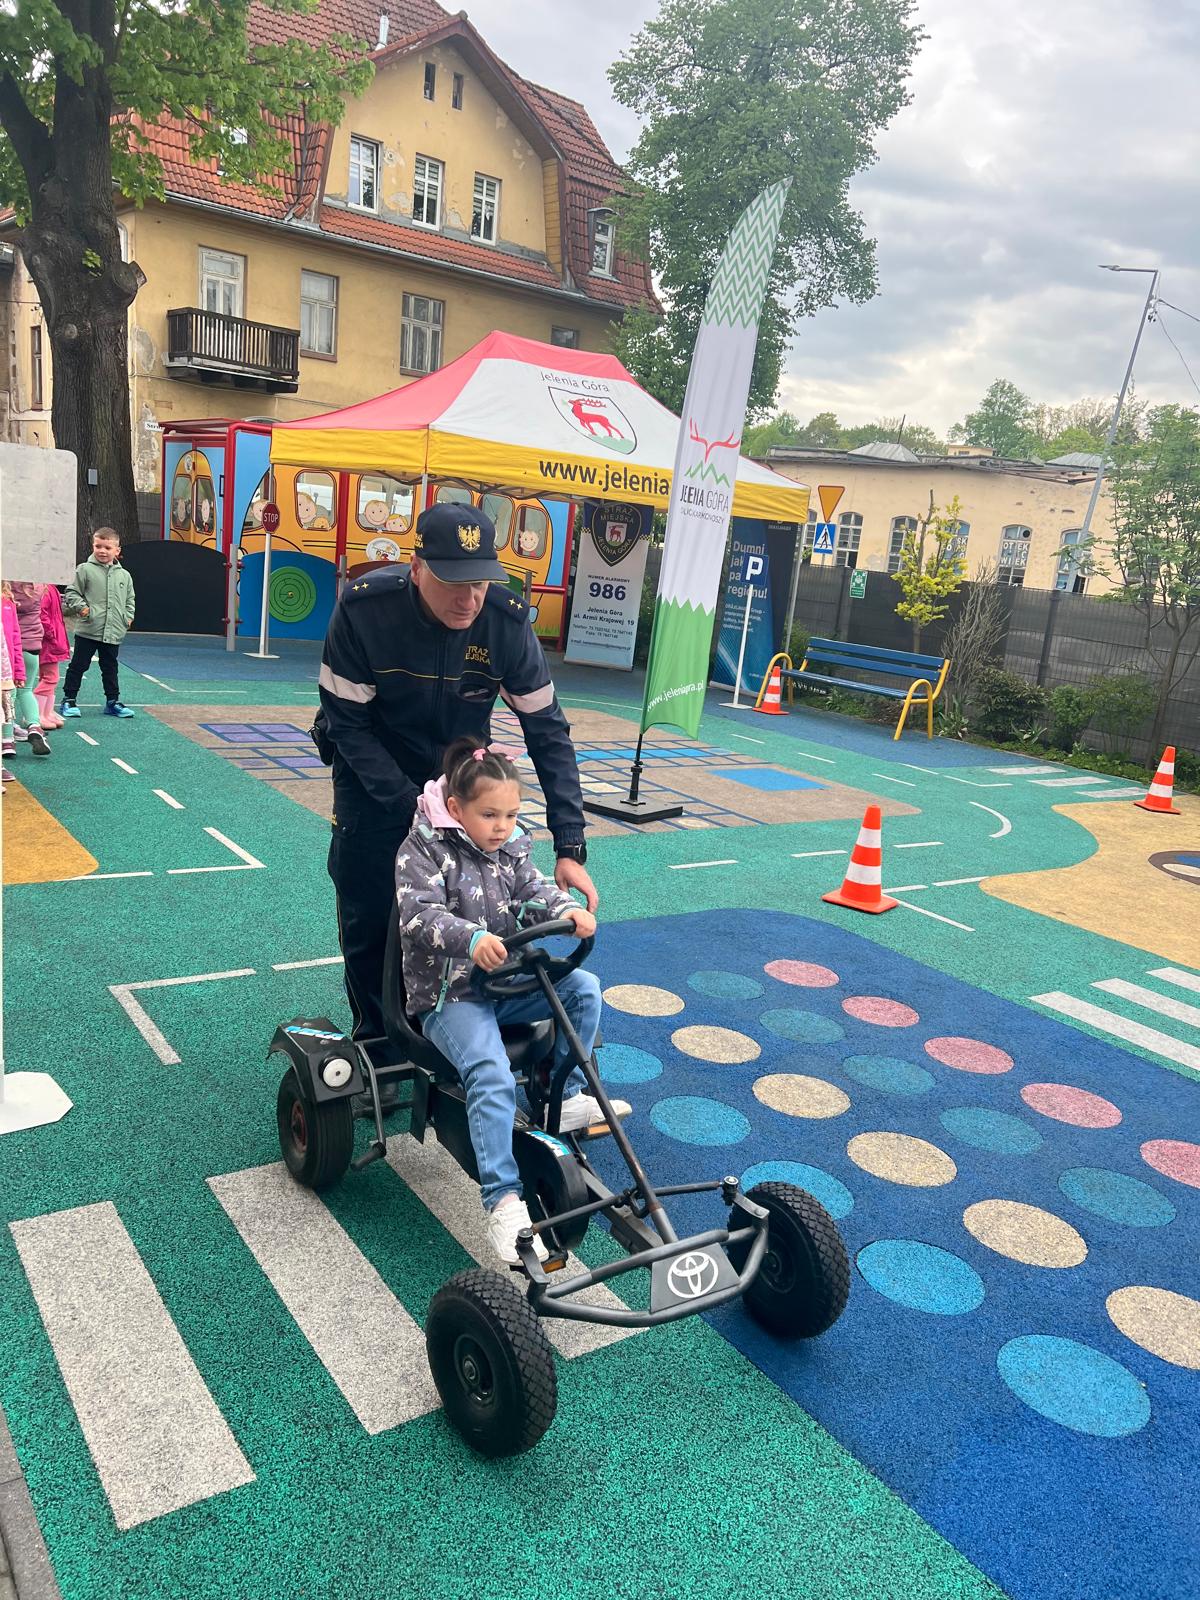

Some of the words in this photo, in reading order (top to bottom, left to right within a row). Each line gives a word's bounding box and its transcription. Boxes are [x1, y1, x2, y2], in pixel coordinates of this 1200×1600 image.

[581, 379, 610, 393] Góra
[539, 460, 671, 496] www.jelenia
[263, 512, 279, 524] STOP
[745, 556, 764, 581] P
[589, 582, 626, 601] 986
[727, 585, 768, 599] reginu!
[587, 606, 608, 615] Jelenia
[465, 652, 491, 665] EJSKA
